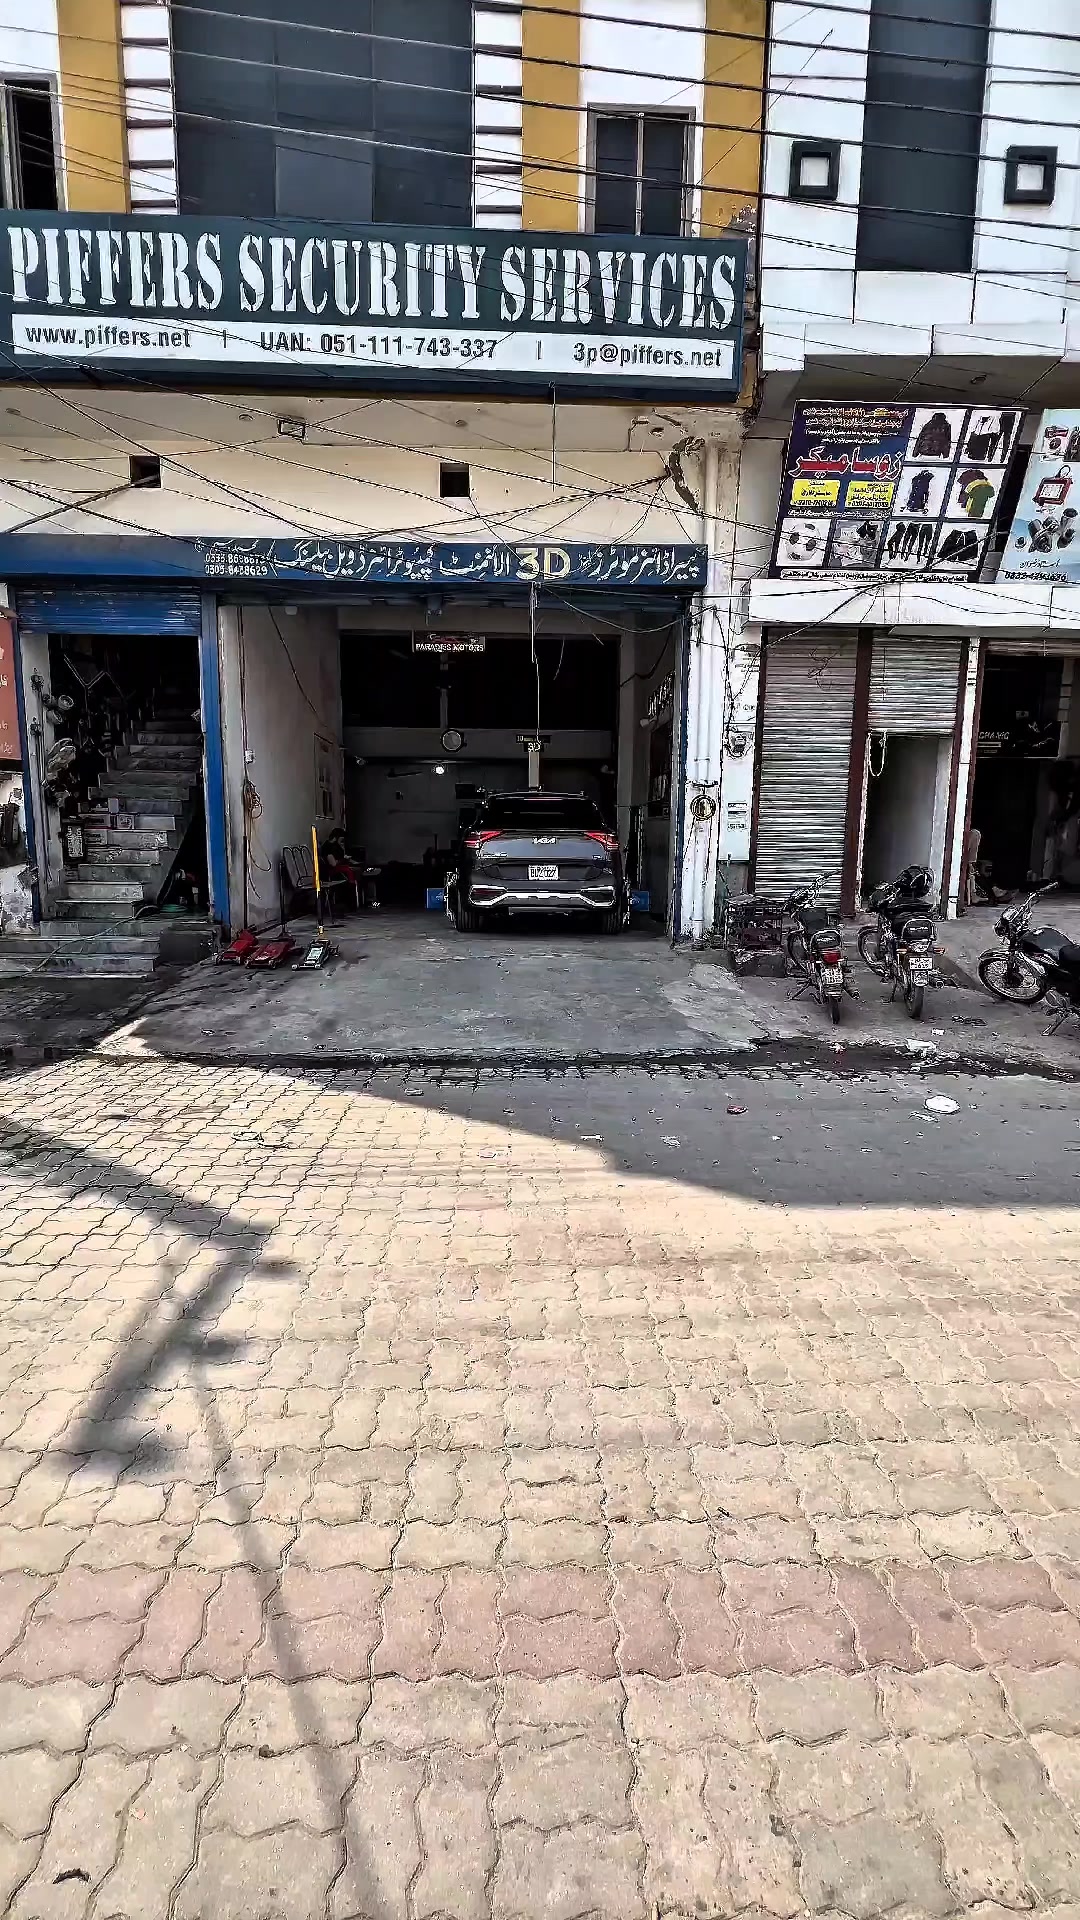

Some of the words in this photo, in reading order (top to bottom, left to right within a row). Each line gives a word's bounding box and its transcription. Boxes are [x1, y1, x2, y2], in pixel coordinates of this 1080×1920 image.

[7, 227, 224, 310] PIFFERS
[239, 234, 486, 318] SECURITY
[500, 246, 736, 330] SERVICES
[25, 325, 191, 350] www.piffers.net
[260, 331, 312, 353] UAN:
[320, 333, 498, 359] 051-111-743-337
[572, 342, 722, 368] 3p@piffers.net
[515, 547, 571, 580] 3D
